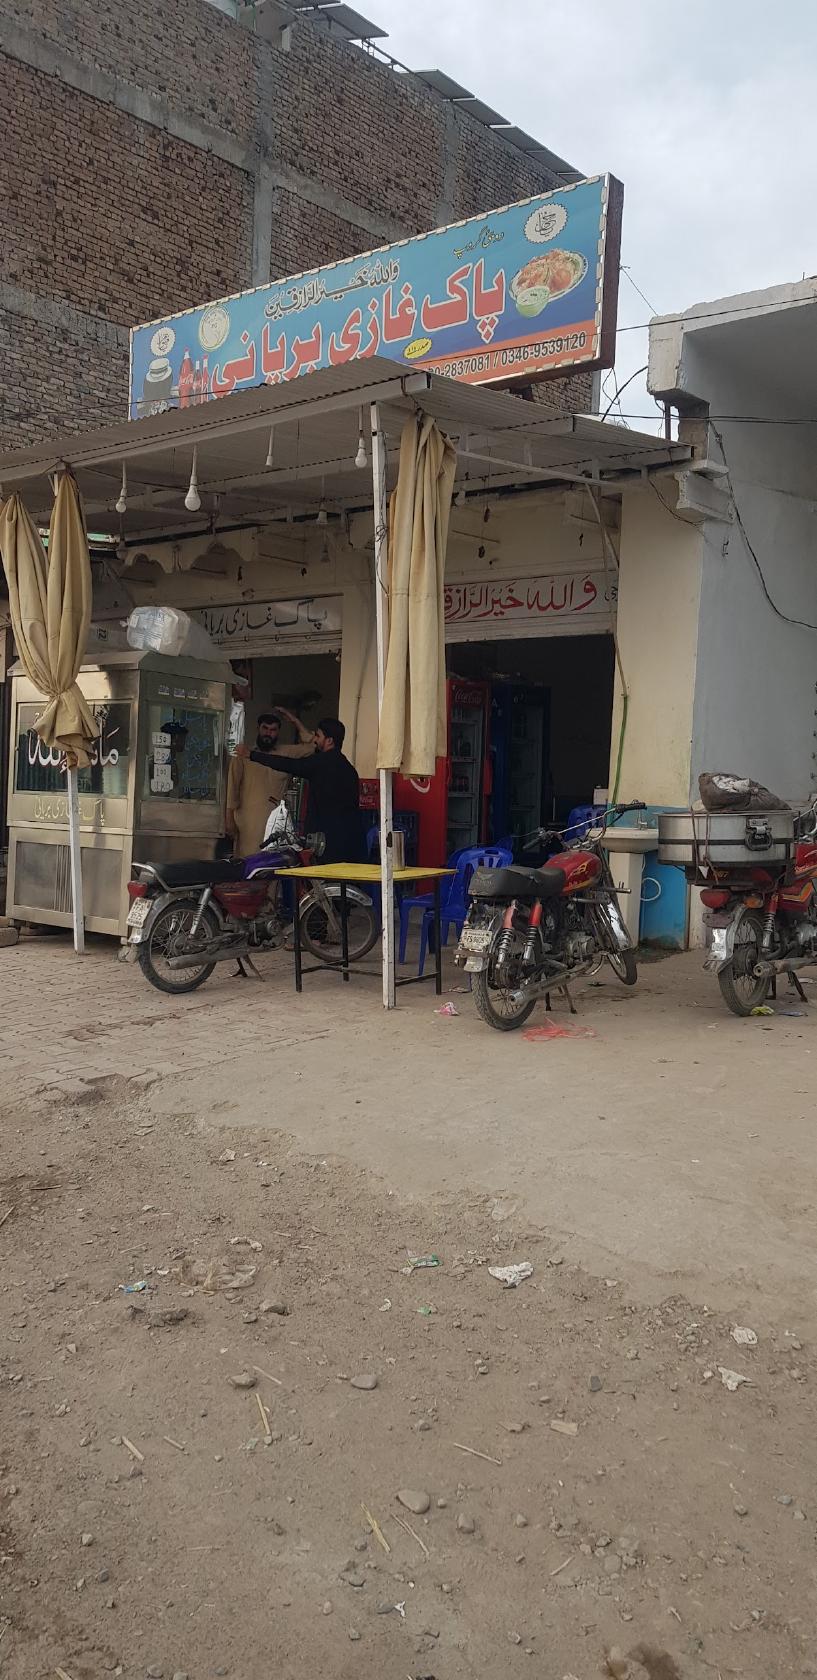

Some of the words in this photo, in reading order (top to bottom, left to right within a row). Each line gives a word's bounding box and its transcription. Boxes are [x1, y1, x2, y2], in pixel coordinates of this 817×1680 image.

[421, 258, 505, 344] پاک
[328, 283, 416, 366] غازی
[501, 331, 587, 366] 0346-9539120
[225, 606, 273, 636] غازی
[274, 598, 328, 630] پاک
